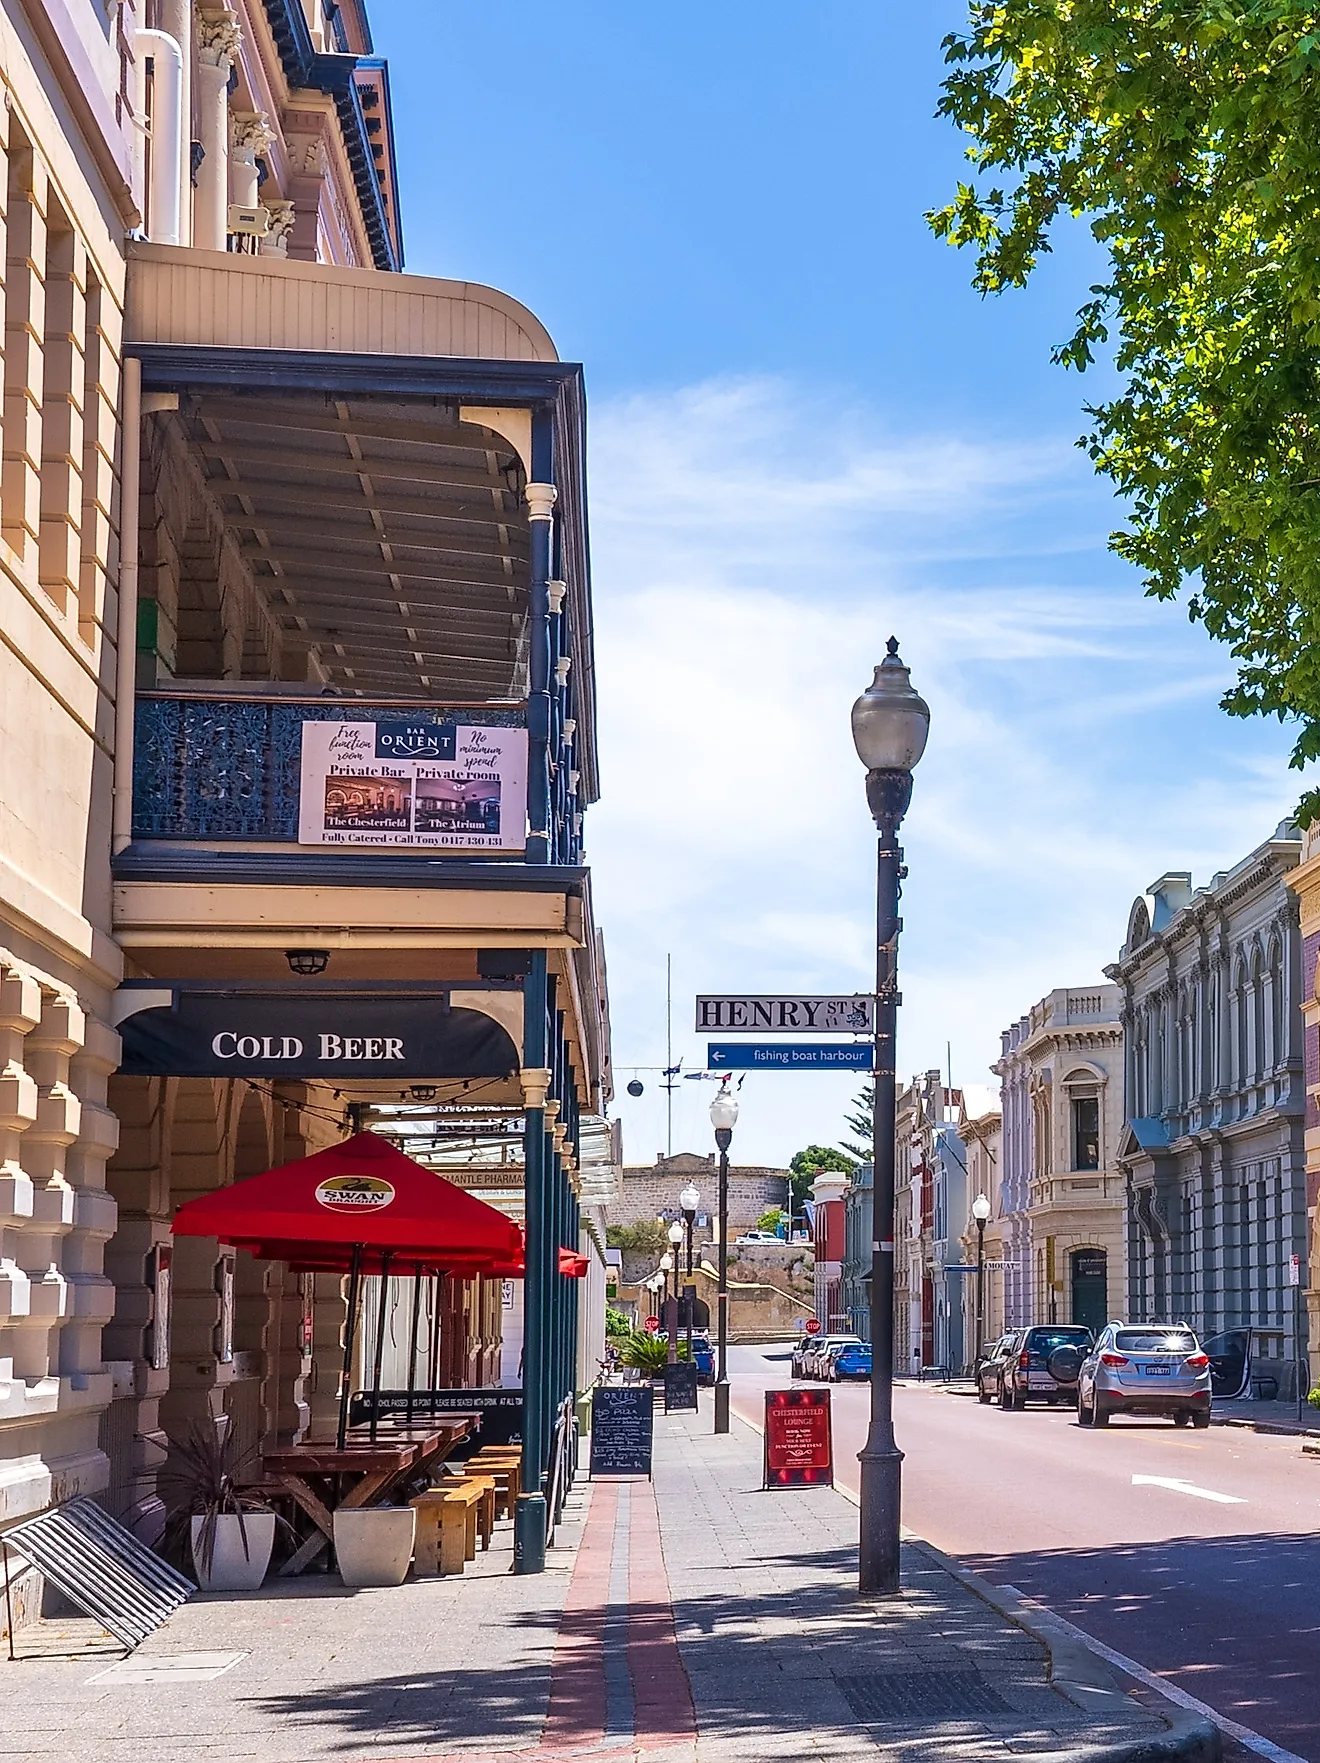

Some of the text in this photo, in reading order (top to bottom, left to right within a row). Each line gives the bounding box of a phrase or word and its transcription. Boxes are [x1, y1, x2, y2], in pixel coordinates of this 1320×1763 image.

[337, 725, 360, 738] Free
[470, 730, 488, 744] No
[329, 736, 372, 751] function
[381, 735, 451, 749] ORIENT
[337, 752, 364, 760] room
[459, 745, 503, 755] minimum
[463, 755, 498, 770] spend
[330, 764, 405, 777] Private Bar
[416, 767, 500, 781] Private room
[327, 816, 407, 828] The Chesterfield
[428, 818, 485, 829] The Atrium
[322, 833, 345, 843] Fully
[348, 833, 386, 843] Catered
[394, 834, 413, 843] Call
[415, 835, 438, 846] Tony
[700, 1000, 825, 1027] HENRY
[827, 1001, 848, 1015] ST
[211, 1031, 406, 1060] COLD BEER
[754, 1050, 865, 1063] fishing boat harbour
[484, 1174, 525, 1184] PHARMA
[324, 1190, 385, 1200] SWAN
[806, 1322, 821, 1330] STOP
[603, 1392, 645, 1400] ORIENT
[772, 1408, 824, 1417] CHESTERFIELD
[783, 1418, 814, 1426] LOUNGE
